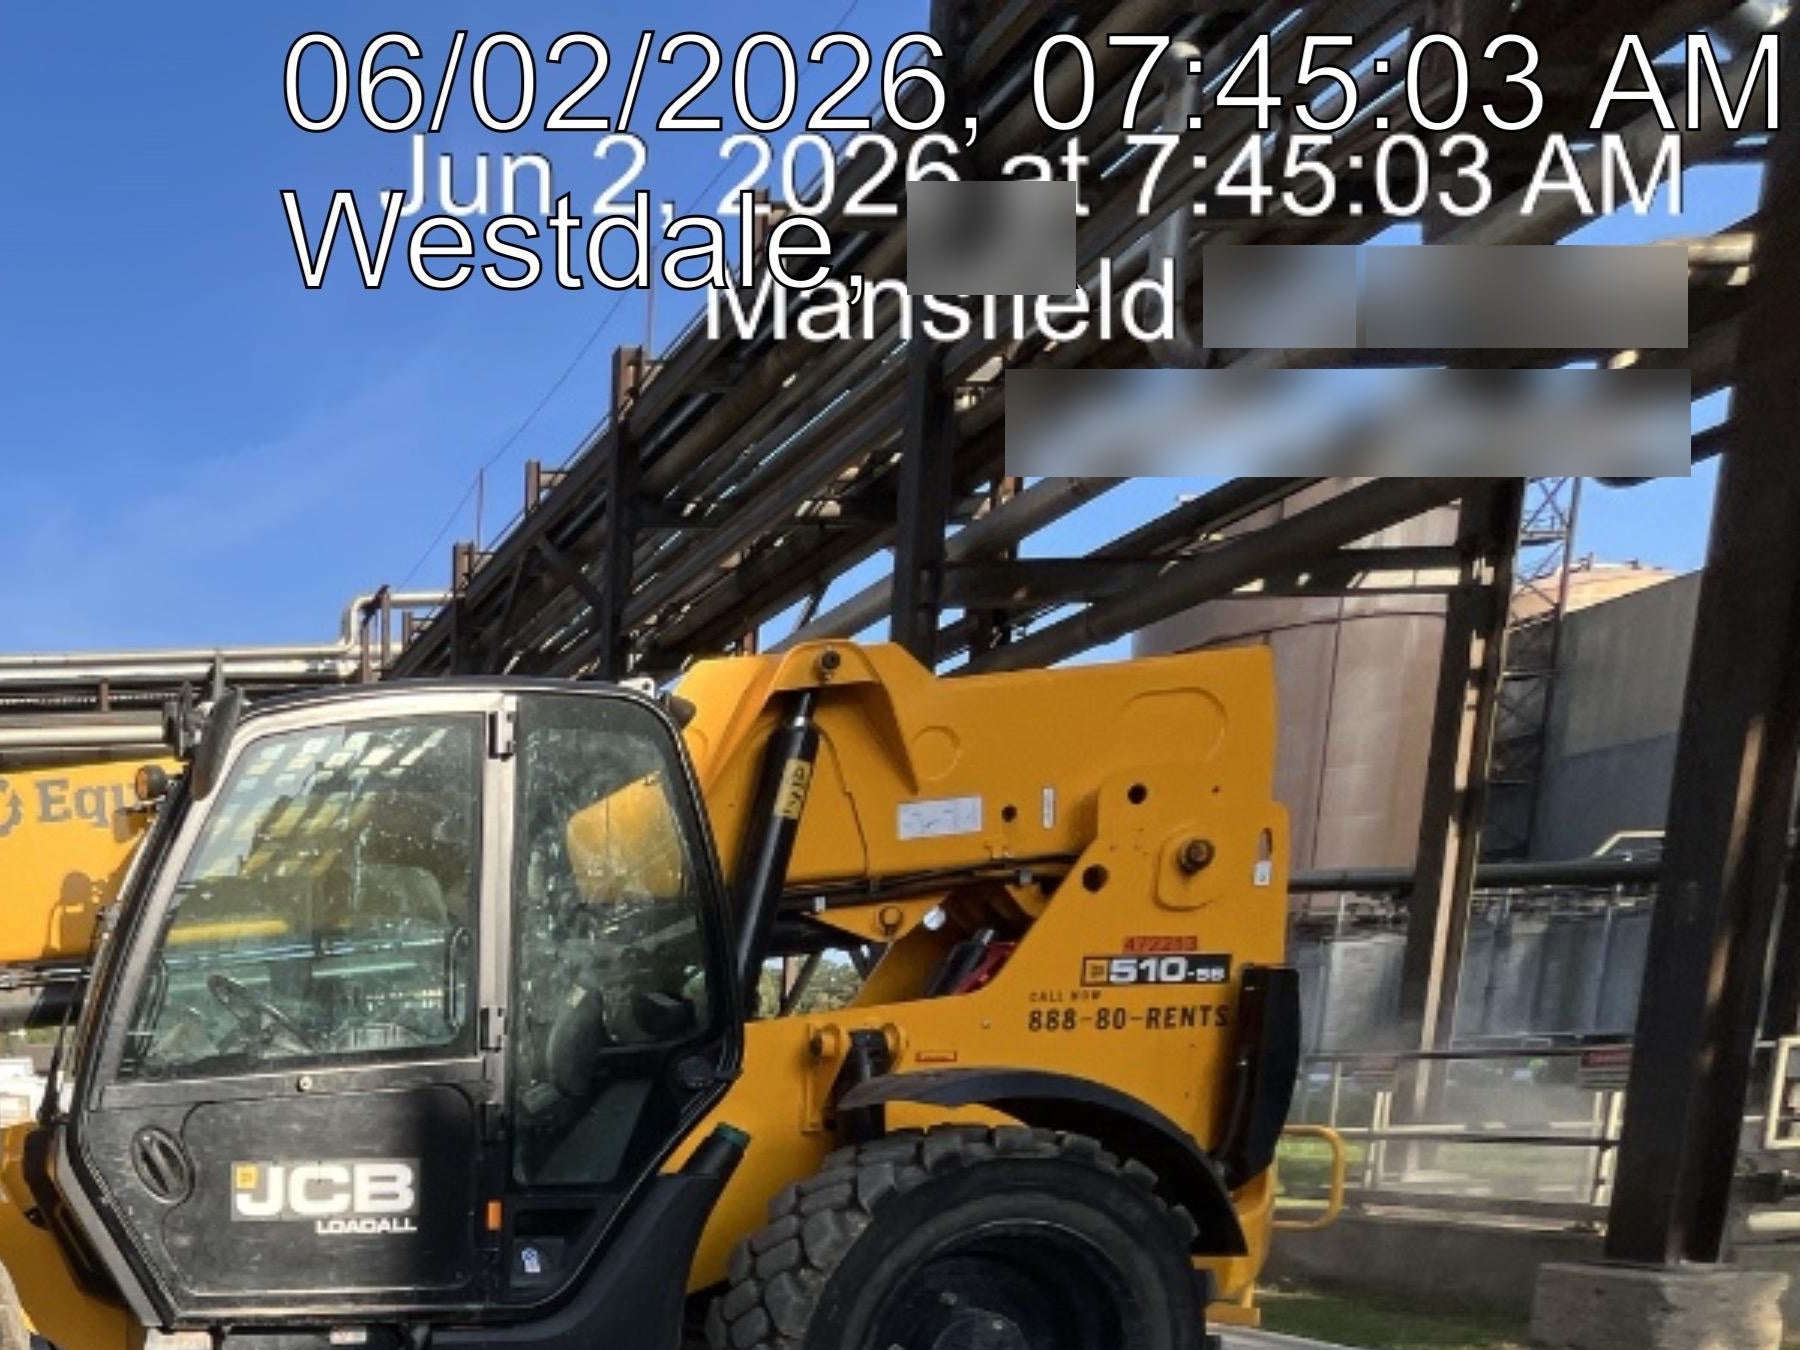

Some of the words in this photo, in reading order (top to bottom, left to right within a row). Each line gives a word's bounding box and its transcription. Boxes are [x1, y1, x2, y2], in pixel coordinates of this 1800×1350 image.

[1028, 1003, 1230, 1031] 888-80-RENTS
[234, 1162, 415, 1216] JCB
[315, 1218, 418, 1234] LOADALL
